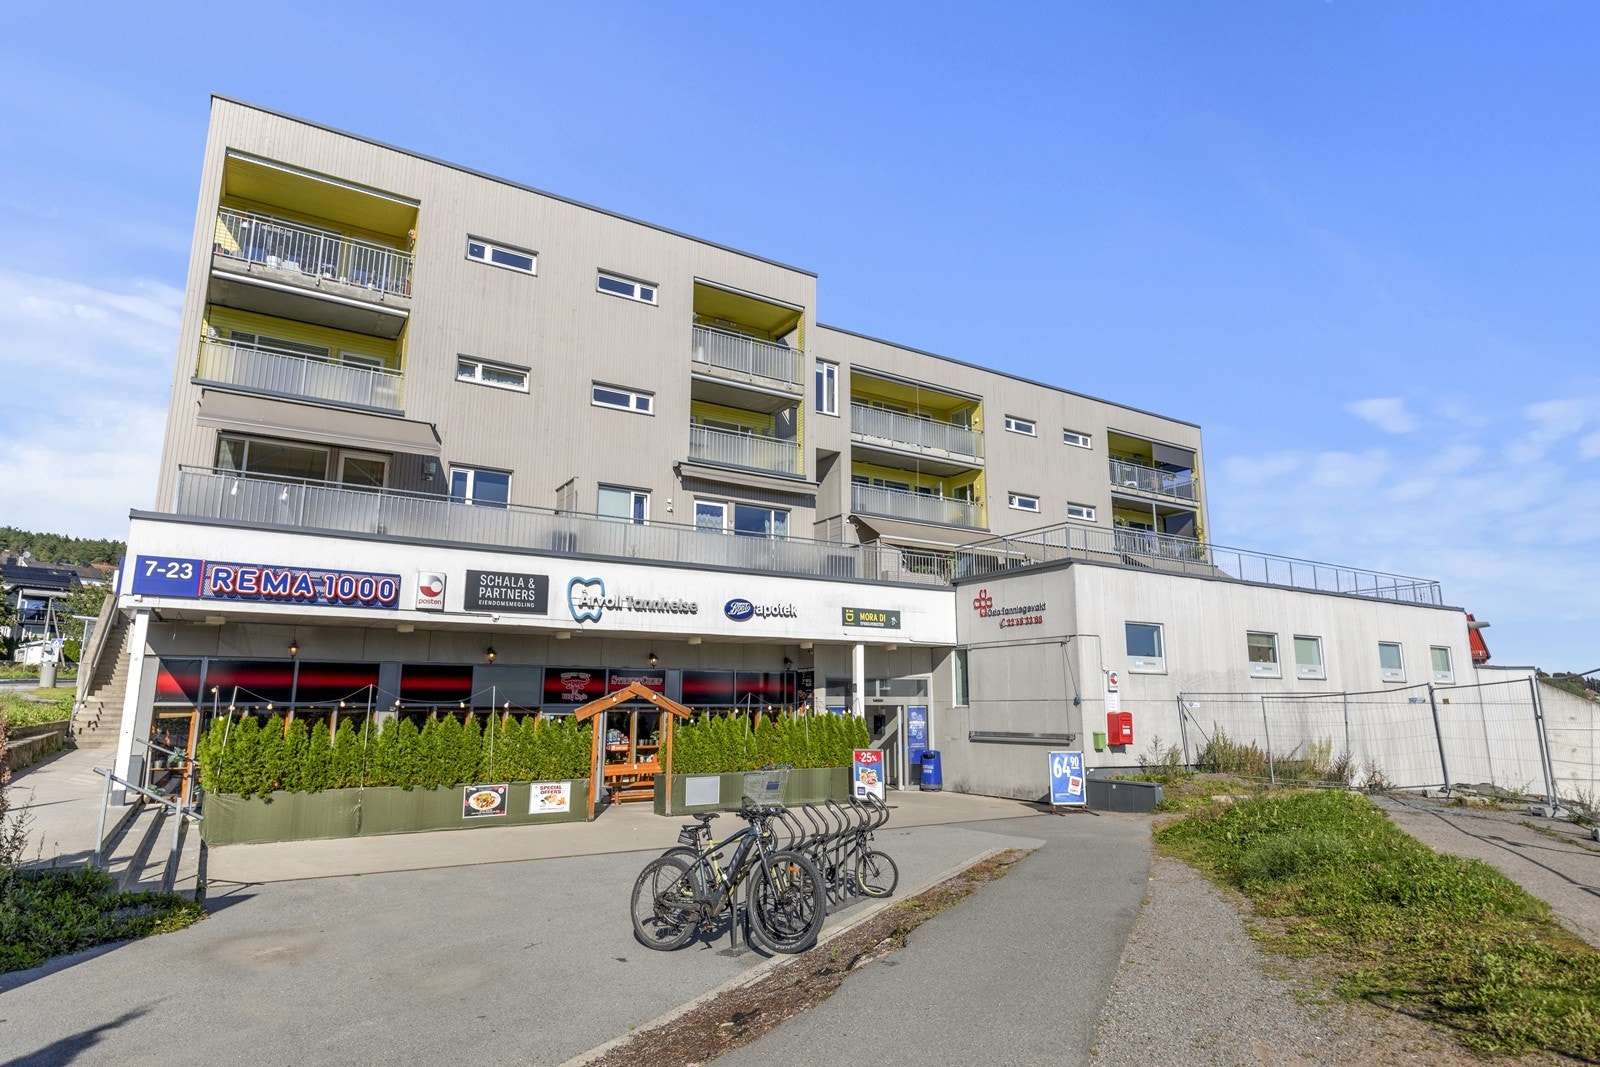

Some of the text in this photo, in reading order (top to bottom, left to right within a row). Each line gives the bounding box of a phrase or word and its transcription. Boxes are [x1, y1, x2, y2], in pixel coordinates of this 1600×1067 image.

[145, 560, 193, 579] 7-23
[211, 566, 397, 601] REMA 1000
[479, 574, 535, 589] SCHALA &
[479, 587, 535, 601] PARTNERS
[478, 600, 535, 608] EIENDOMSMEGLING
[625, 594, 699, 615] Tannhelse
[754, 603, 797, 619] apotek
[859, 612, 886, 623] MORA DI
[859, 752, 877, 763] -25%
[1053, 756, 1080, 778] 64 90
